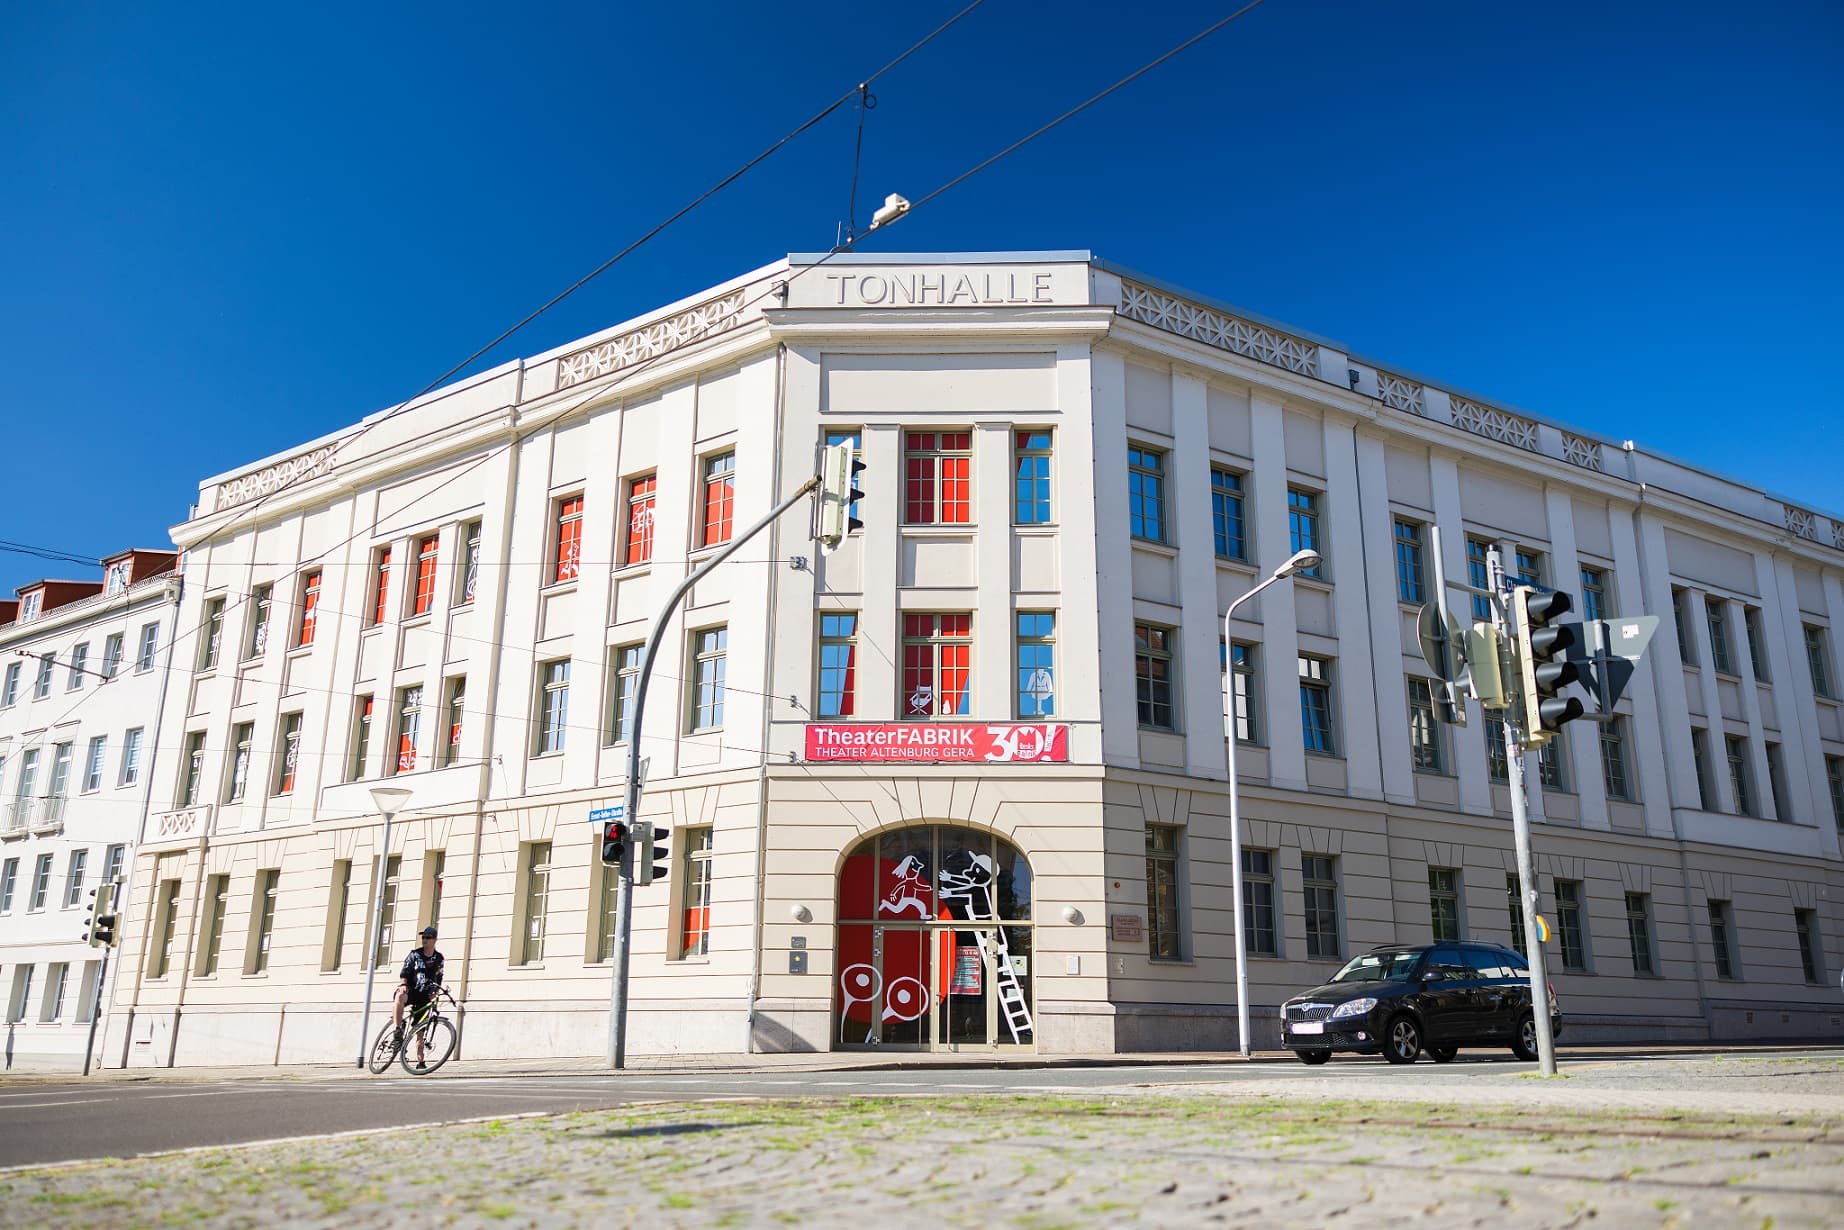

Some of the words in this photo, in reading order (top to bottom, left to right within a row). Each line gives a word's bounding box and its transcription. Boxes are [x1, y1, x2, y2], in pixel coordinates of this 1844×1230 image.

[827, 272, 1053, 304] TONHALLE
[815, 728, 974, 746] TheaterFABRIK
[815, 747, 867, 757] THEATER
[870, 747, 939, 757] ALTENBURG
[943, 747, 975, 757] GERA
